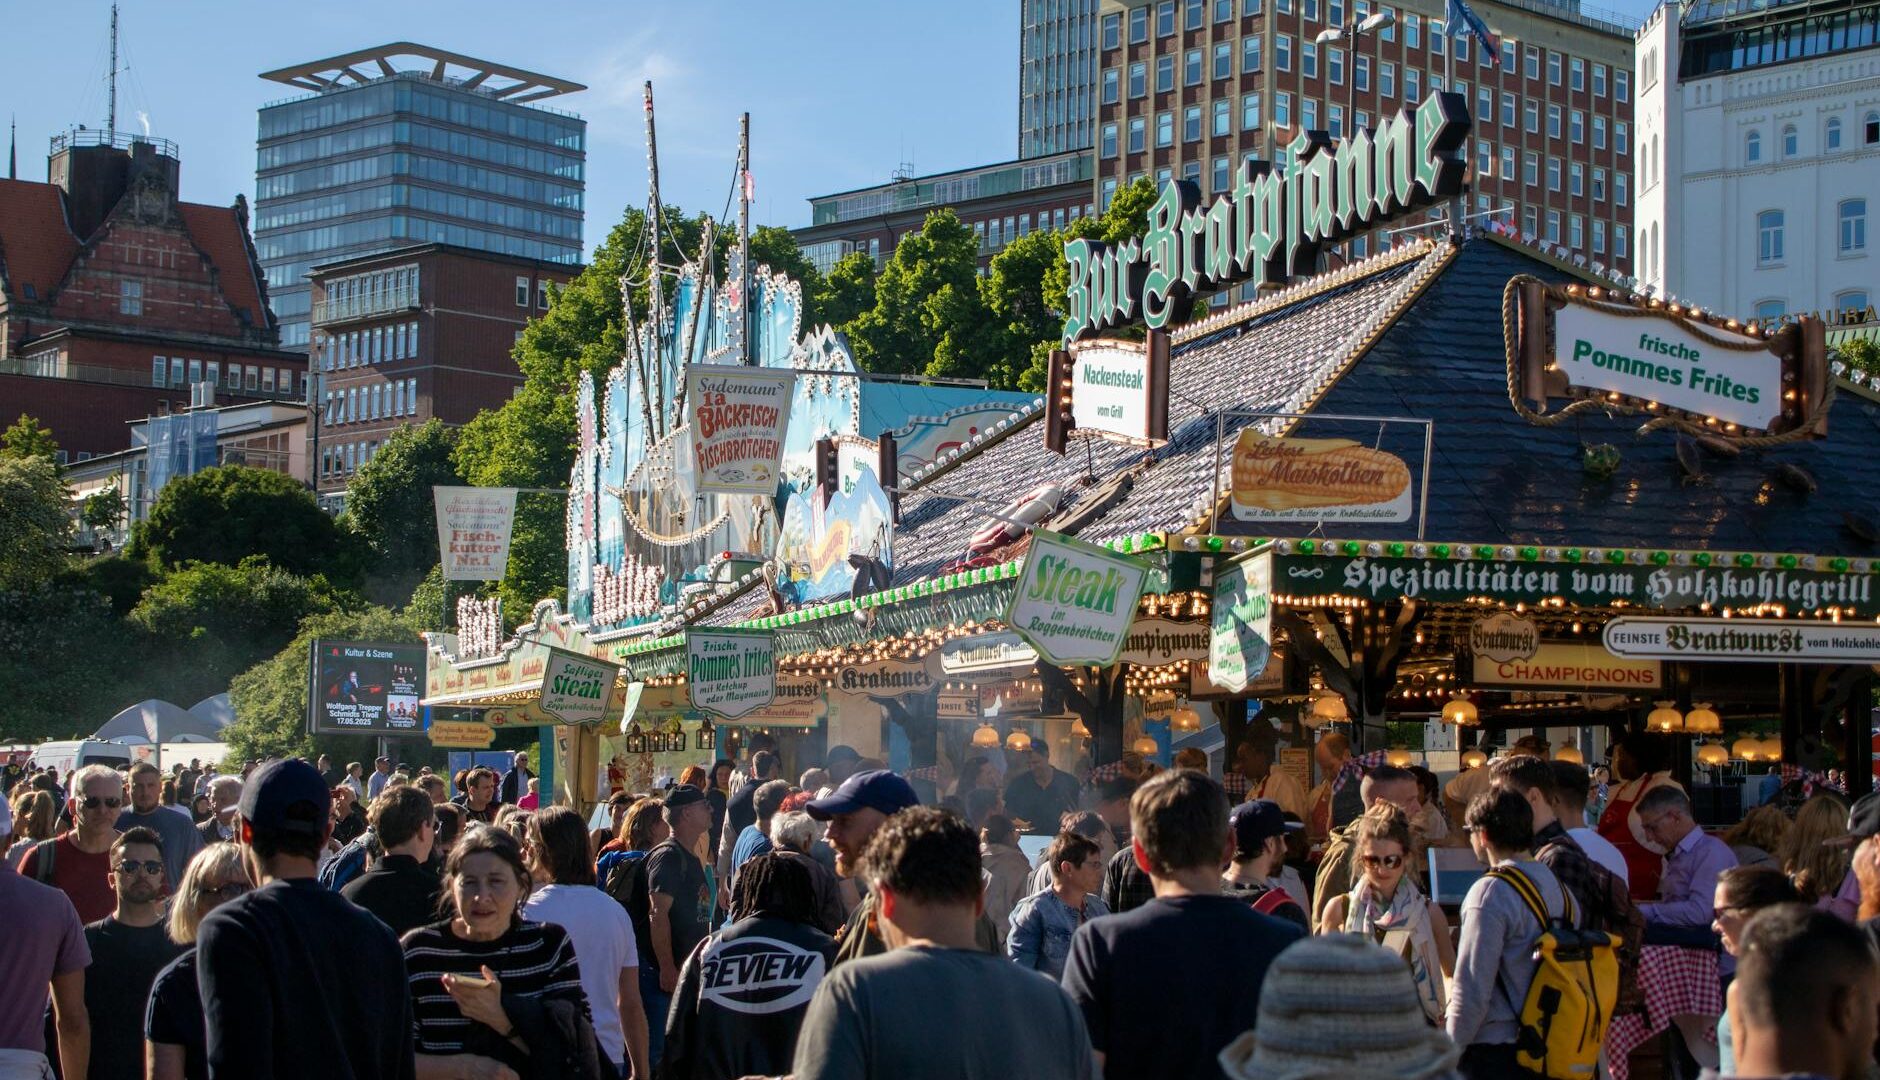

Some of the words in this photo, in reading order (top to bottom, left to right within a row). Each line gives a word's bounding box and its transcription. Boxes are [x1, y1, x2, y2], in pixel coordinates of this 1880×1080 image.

[1062, 237, 1138, 351] Zur
[1142, 90, 1449, 329] Bratpfanne
[1639, 333, 1701, 362] frische
[1083, 364, 1144, 390] Nackensteak
[1572, 339, 1683, 386] Pommes
[1689, 367, 1761, 404] Frites
[697, 404, 779, 438] BACKFISCH
[1097, 406, 1109, 417] vom
[1110, 405, 1124, 418] Grill
[1258, 460, 1385, 487] Maiskolben
[1245, 509, 1257, 517] mit
[1279, 509, 1293, 517] und
[449, 541, 502, 553] kutter
[452, 530, 503, 541] Fisch-
[1027, 554, 1126, 614] Steak
[1343, 557, 1560, 598] Spezialitäten
[1572, 568, 1634, 595] vom
[1645, 568, 1871, 609] Holzkohlegrill
[1051, 607, 1066, 620] im
[1028, 616, 1115, 642] Roggenbrötchen
[1472, 624, 1536, 650] Bratwurst
[1613, 632, 1660, 645] FEINSTE
[1666, 625, 1804, 653] Bratwurst
[1807, 639, 1828, 648] vom
[345, 648, 365, 657] Kultur
[372, 650, 393, 658] Szene
[704, 641, 737, 652] Frische
[1122, 628, 1210, 658] mpignons
[691, 653, 740, 683] Pommes
[744, 647, 773, 678] frites
[1498, 663, 1654, 684] CHAMPIGNONS
[551, 674, 604, 699] Steak
[699, 685, 713, 694] mit
[716, 681, 748, 692] Ketchup
[842, 667, 932, 689] Krakauer
[326, 702, 357, 711] Wolfgang
[358, 703, 383, 712] Trepper
[706, 695, 723, 704] oder
[329, 710, 360, 718] Schmidts
[362, 710, 379, 718] Tivoli
[337, 717, 372, 726] 17.05.2025
